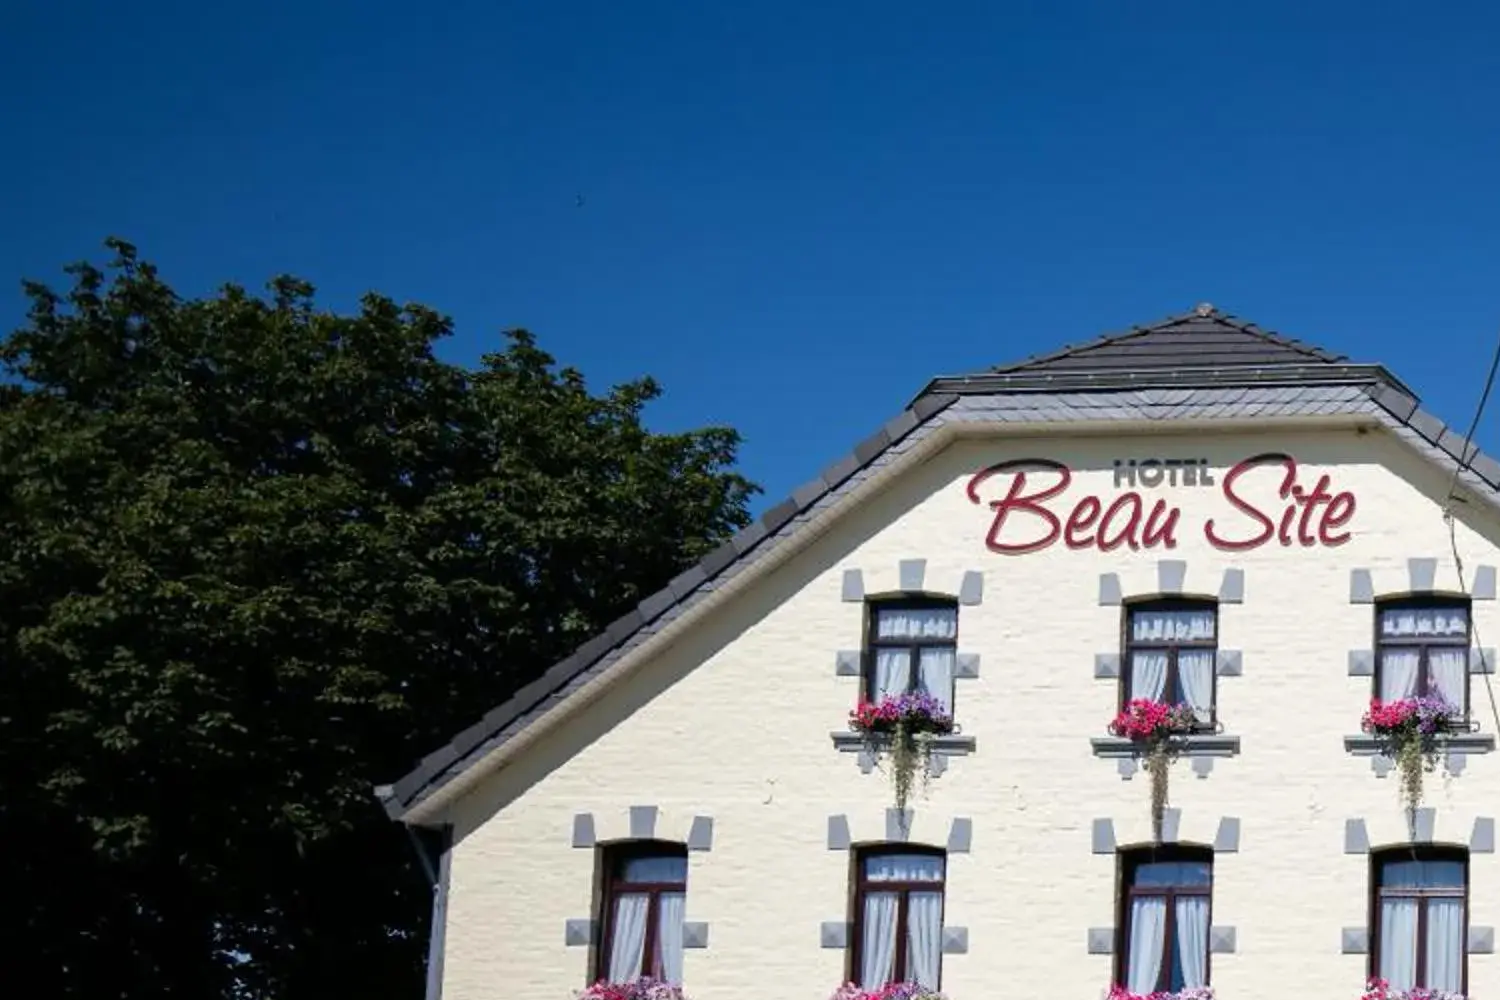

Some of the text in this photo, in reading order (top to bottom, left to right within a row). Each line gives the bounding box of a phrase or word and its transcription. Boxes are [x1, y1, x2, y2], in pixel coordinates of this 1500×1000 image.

[967, 453, 1357, 555] Beau Site
[1113, 458, 1216, 488] HOTEL
